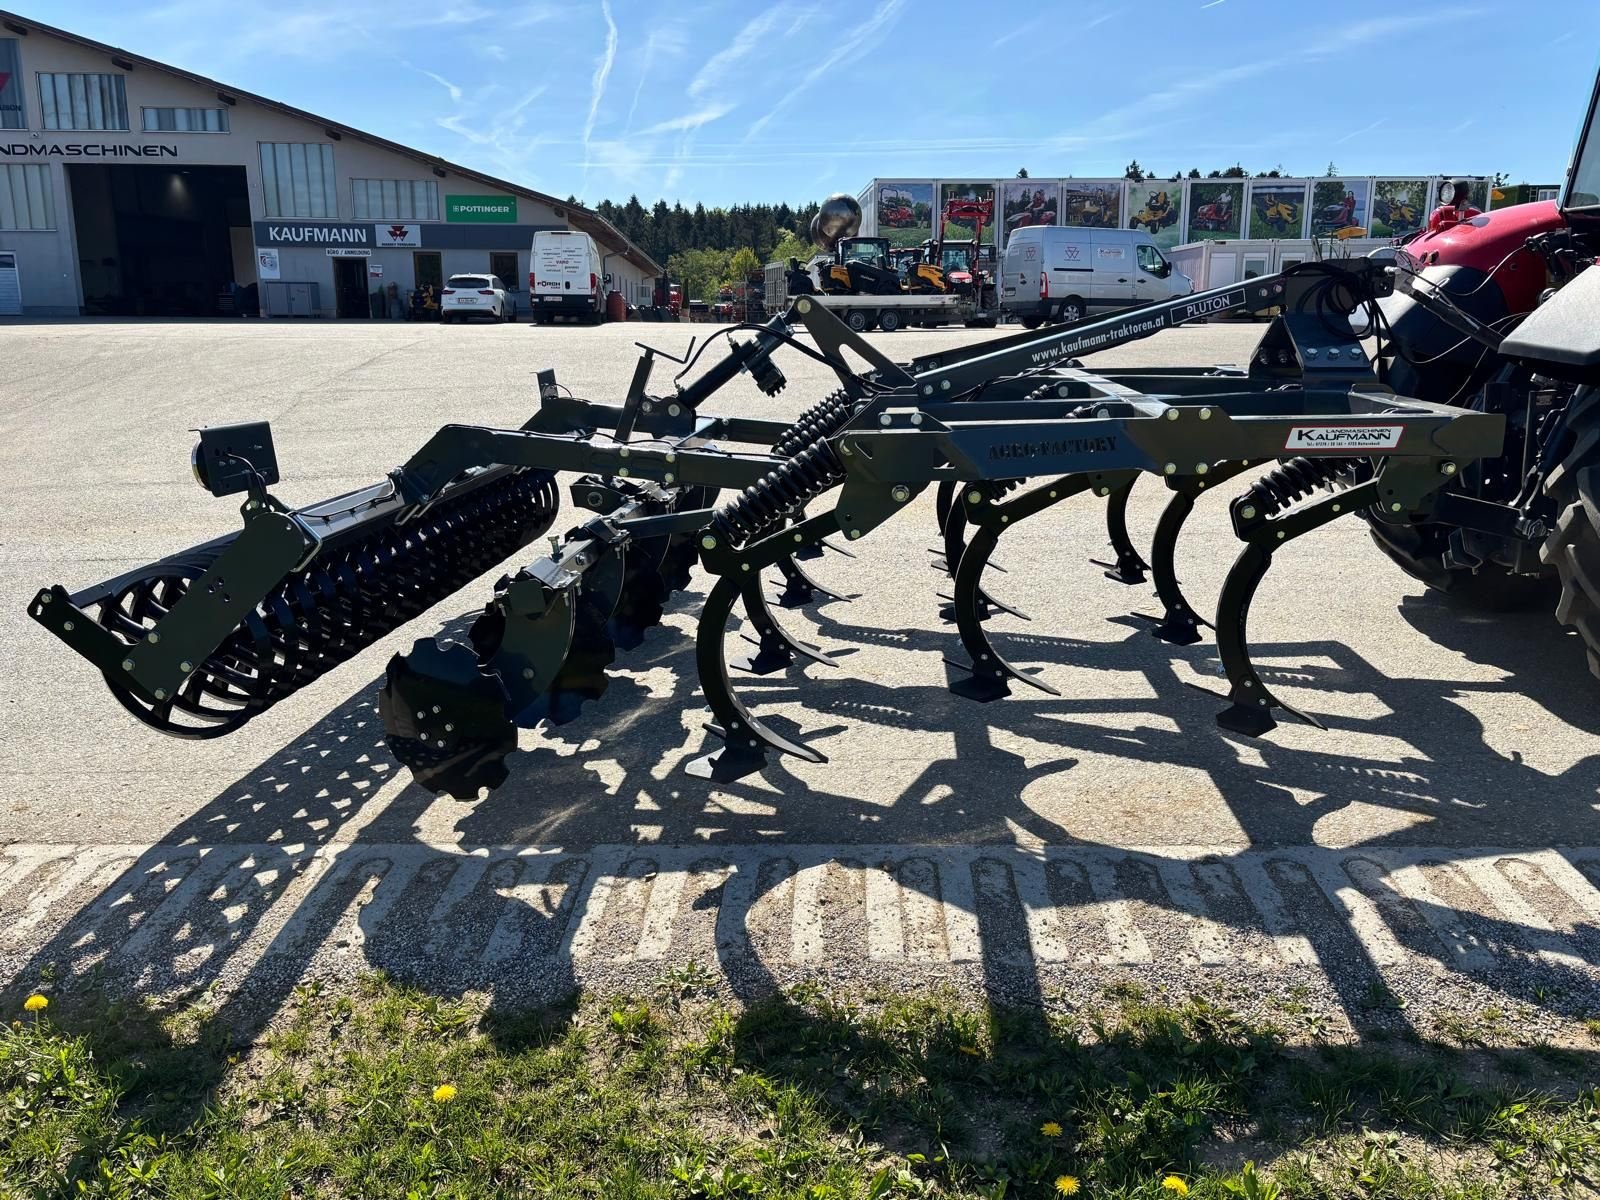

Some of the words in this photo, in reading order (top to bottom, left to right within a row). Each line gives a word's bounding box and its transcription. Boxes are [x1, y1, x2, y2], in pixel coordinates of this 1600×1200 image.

[269, 226, 366, 243] KAUFMANN
[1186, 295, 1230, 317] PLUTON
[1031, 315, 1165, 363] www.kaufmann-traktoren.at
[1297, 430, 1391, 441] KAUFMANN
